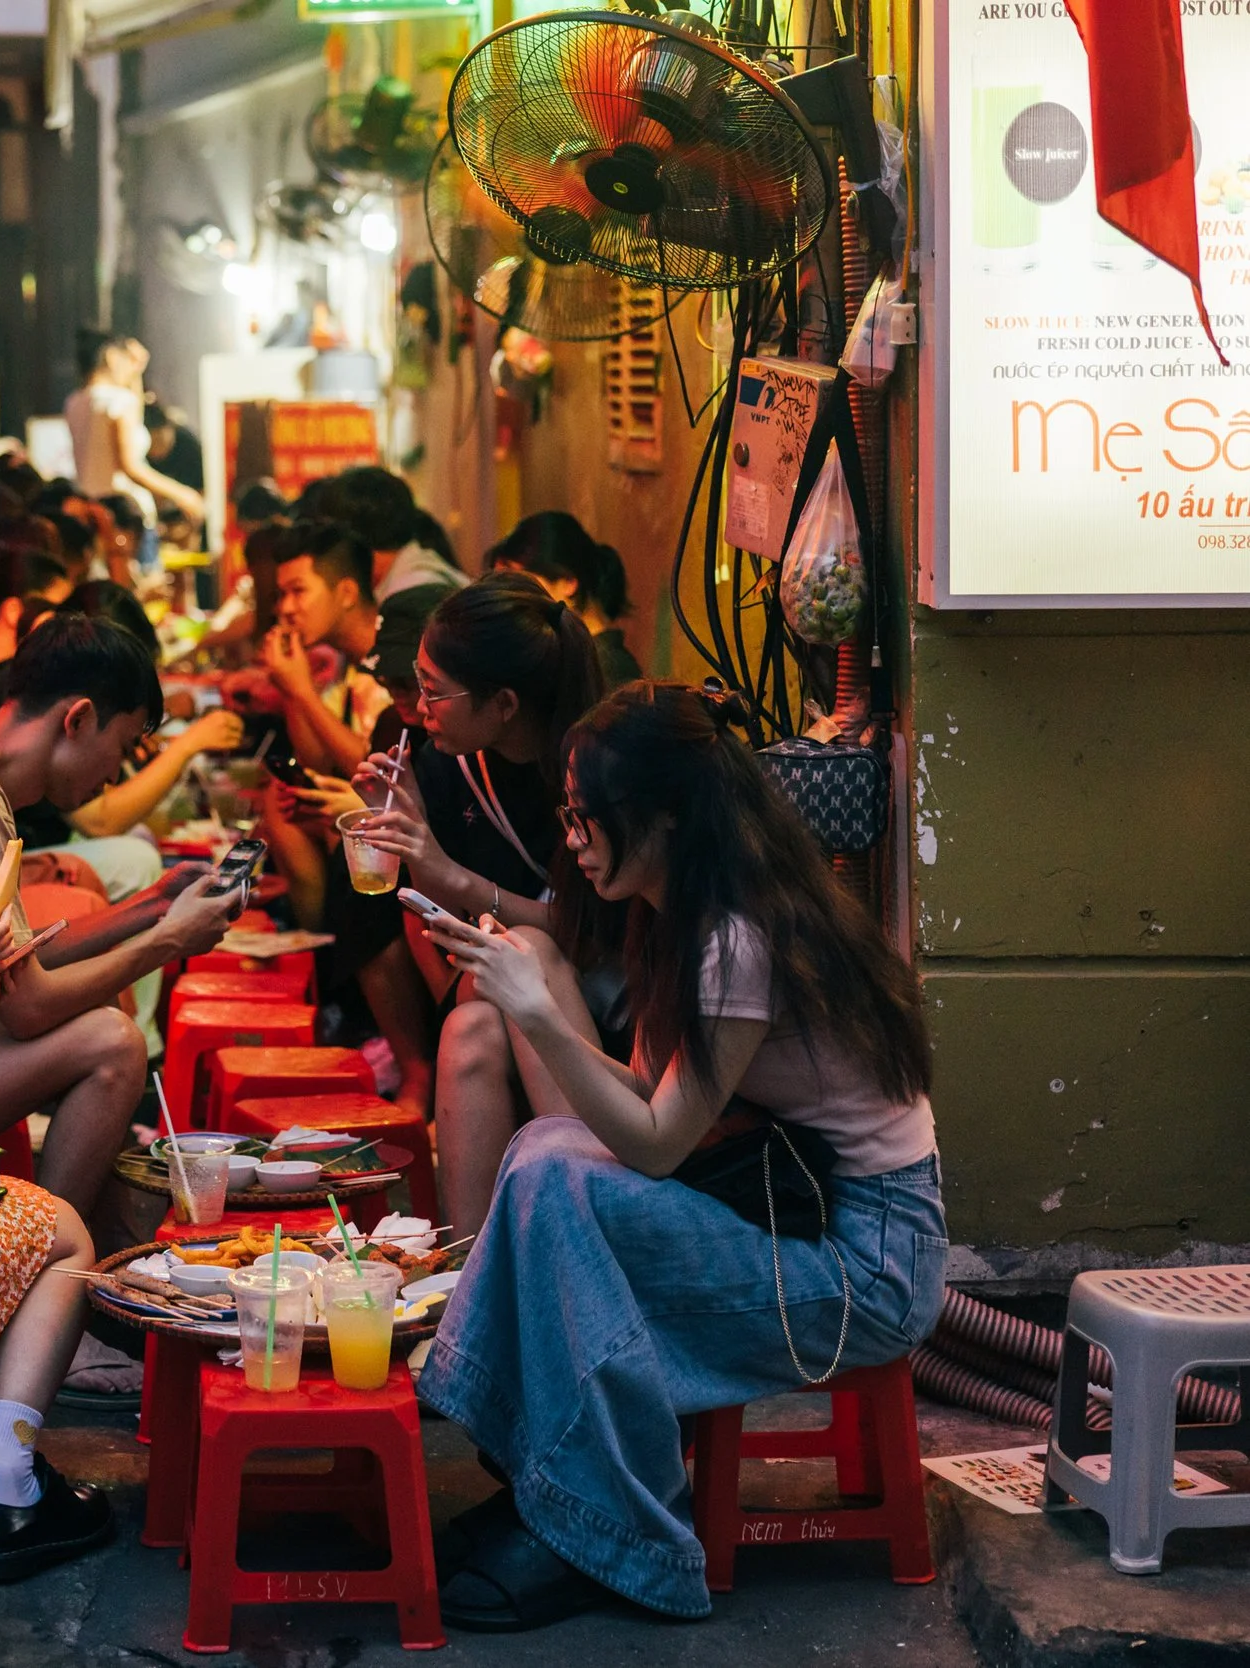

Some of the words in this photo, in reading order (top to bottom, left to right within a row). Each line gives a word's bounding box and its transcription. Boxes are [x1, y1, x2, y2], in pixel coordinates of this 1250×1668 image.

[978, 4, 1010, 20] ARE
[1014, 2, 1047, 19] YOU
[1179, 0, 1206, 16] OST
[1209, 0, 1242, 16] OUT
[1199, 220, 1245, 236] RINK
[1205, 244, 1250, 261] HON
[984, 316, 1029, 329] SLOW
[1094, 315, 1132, 328] NEW
[1037, 337, 1090, 350] FRESH
[1095, 337, 1141, 350] COLD
[1144, 336, 1193, 350] JUICE
[1137, 491, 1170, 518] 10
[1178, 483, 1214, 518] ấu
